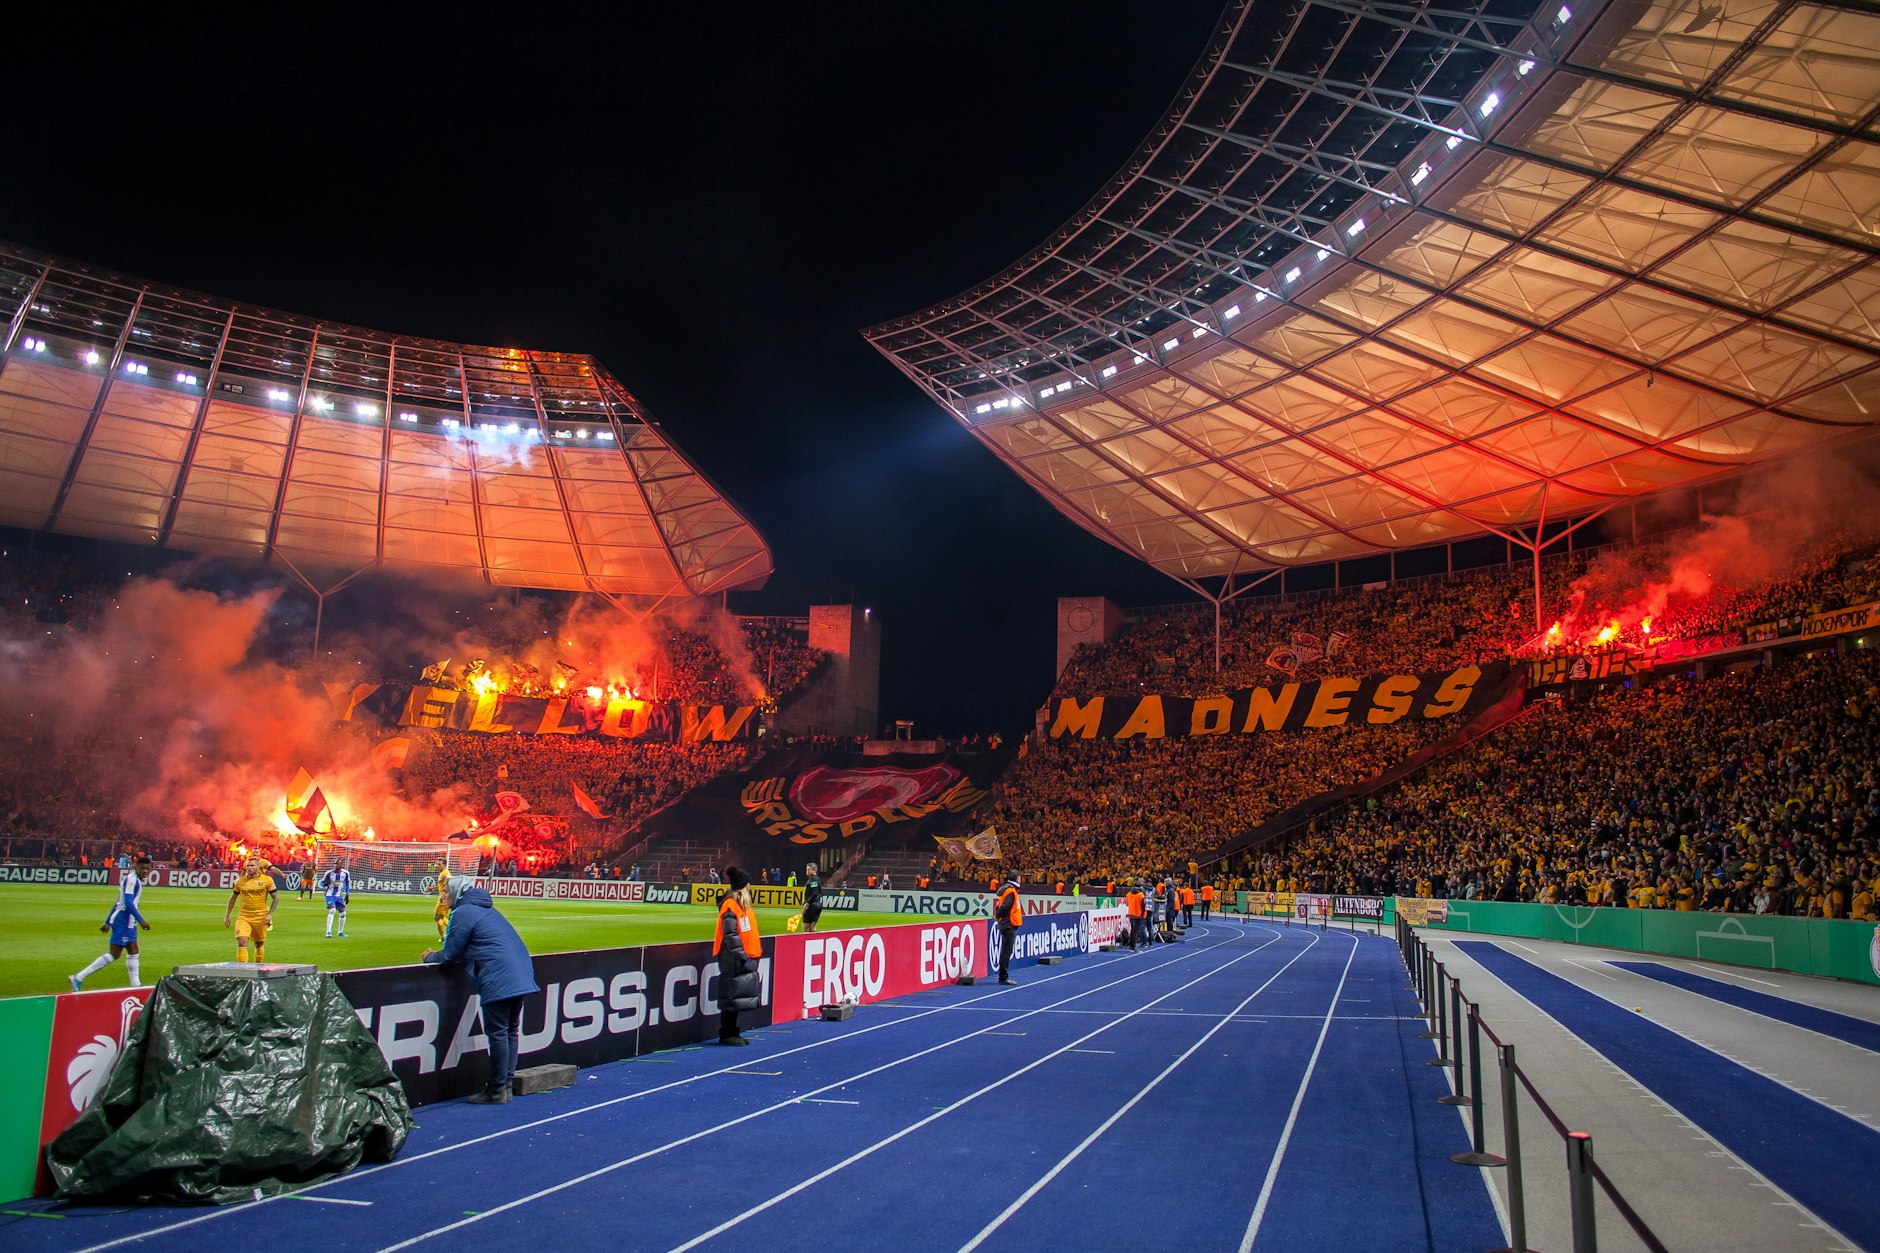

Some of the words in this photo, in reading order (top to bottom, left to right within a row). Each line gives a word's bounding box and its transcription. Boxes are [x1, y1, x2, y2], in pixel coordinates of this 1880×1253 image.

[1050, 665, 1482, 739] MADNESS
[322, 681, 757, 743] YELLOW
[168, 870, 211, 888] ERGO
[368, 878, 412, 892] Passat
[475, 880, 544, 896] AUHAUS
[558, 881, 644, 899] BAUHAUS
[646, 885, 689, 902] bwin
[696, 887, 804, 906] SPOWETTEN
[819, 890, 856, 908] win
[1010, 934, 1026, 961] er
[1027, 930, 1050, 957] neue
[1051, 922, 1078, 952] Passat
[920, 923, 975, 985] ERGO
[803, 932, 886, 1009] ERGO
[354, 957, 771, 1075] RAUSS.CO
